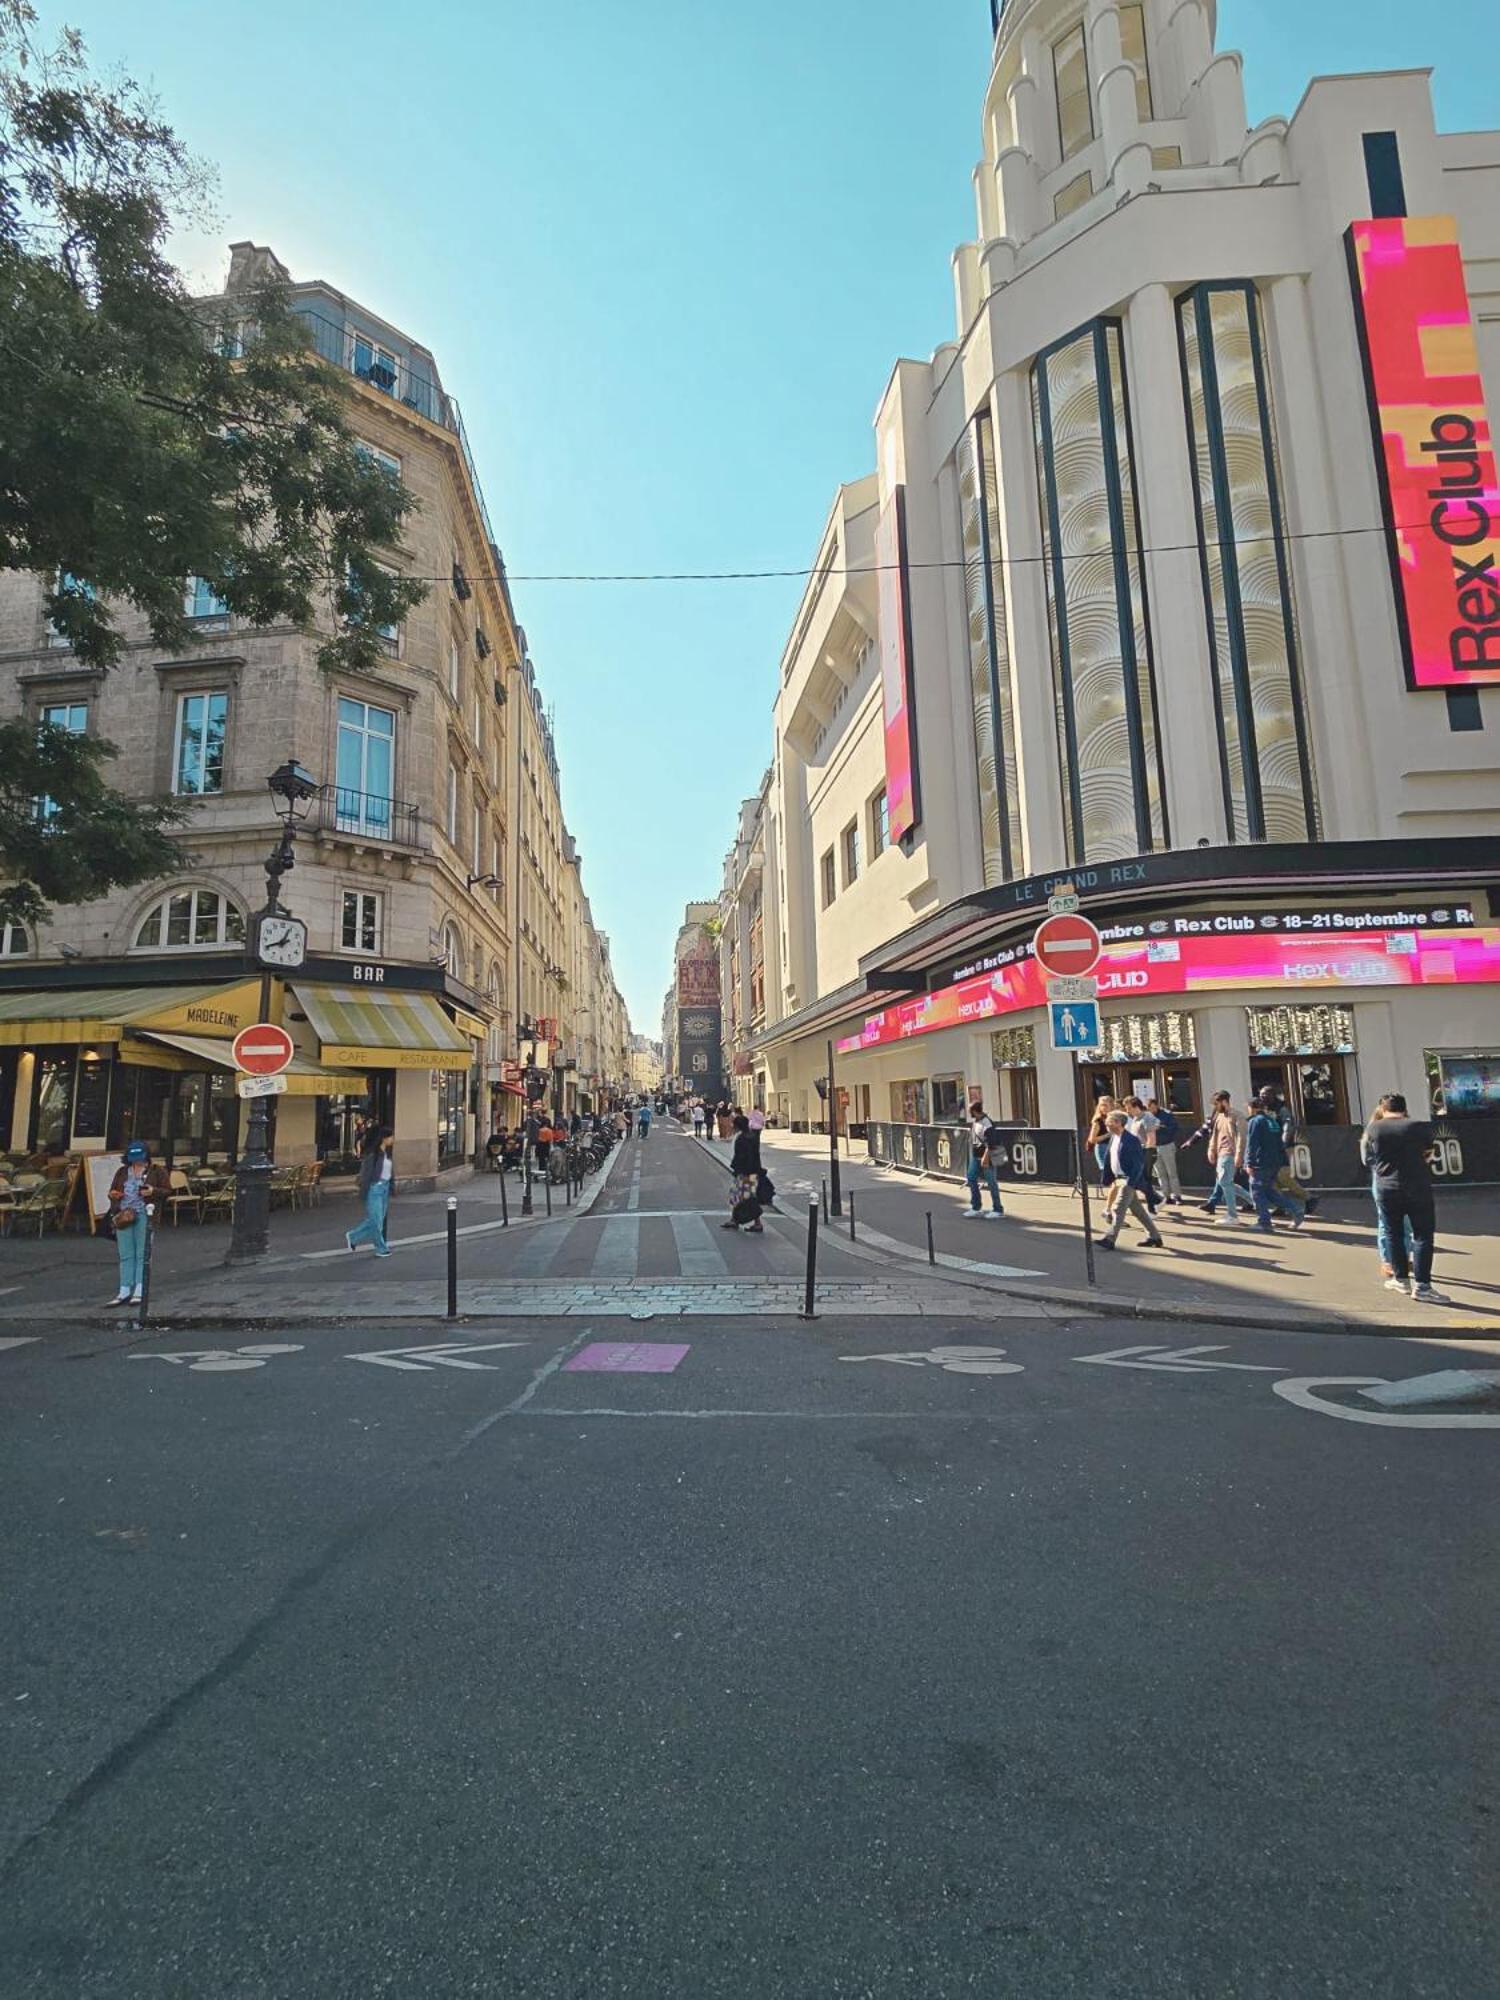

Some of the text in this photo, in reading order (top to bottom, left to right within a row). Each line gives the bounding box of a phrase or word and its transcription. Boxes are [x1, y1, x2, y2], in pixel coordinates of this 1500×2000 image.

[1419, 414, 1490, 546] Club
[1015, 884, 1034, 901] LE
[1110, 864, 1146, 883] REX
[998, 948, 1015, 965] Club
[1174, 918, 1212, 933] Rex
[1214, 915, 1256, 931] Club
[1333, 911, 1428, 929] Septembre
[352, 965, 385, 982] BAR
[187, 1007, 239, 1028] MADELEINE
[400, 1053, 459, 1066] RESTAURANT
[937, 1139, 951, 1169] 90
[1012, 1143, 1038, 1175] 90
[1431, 1138, 1464, 1176] 90
